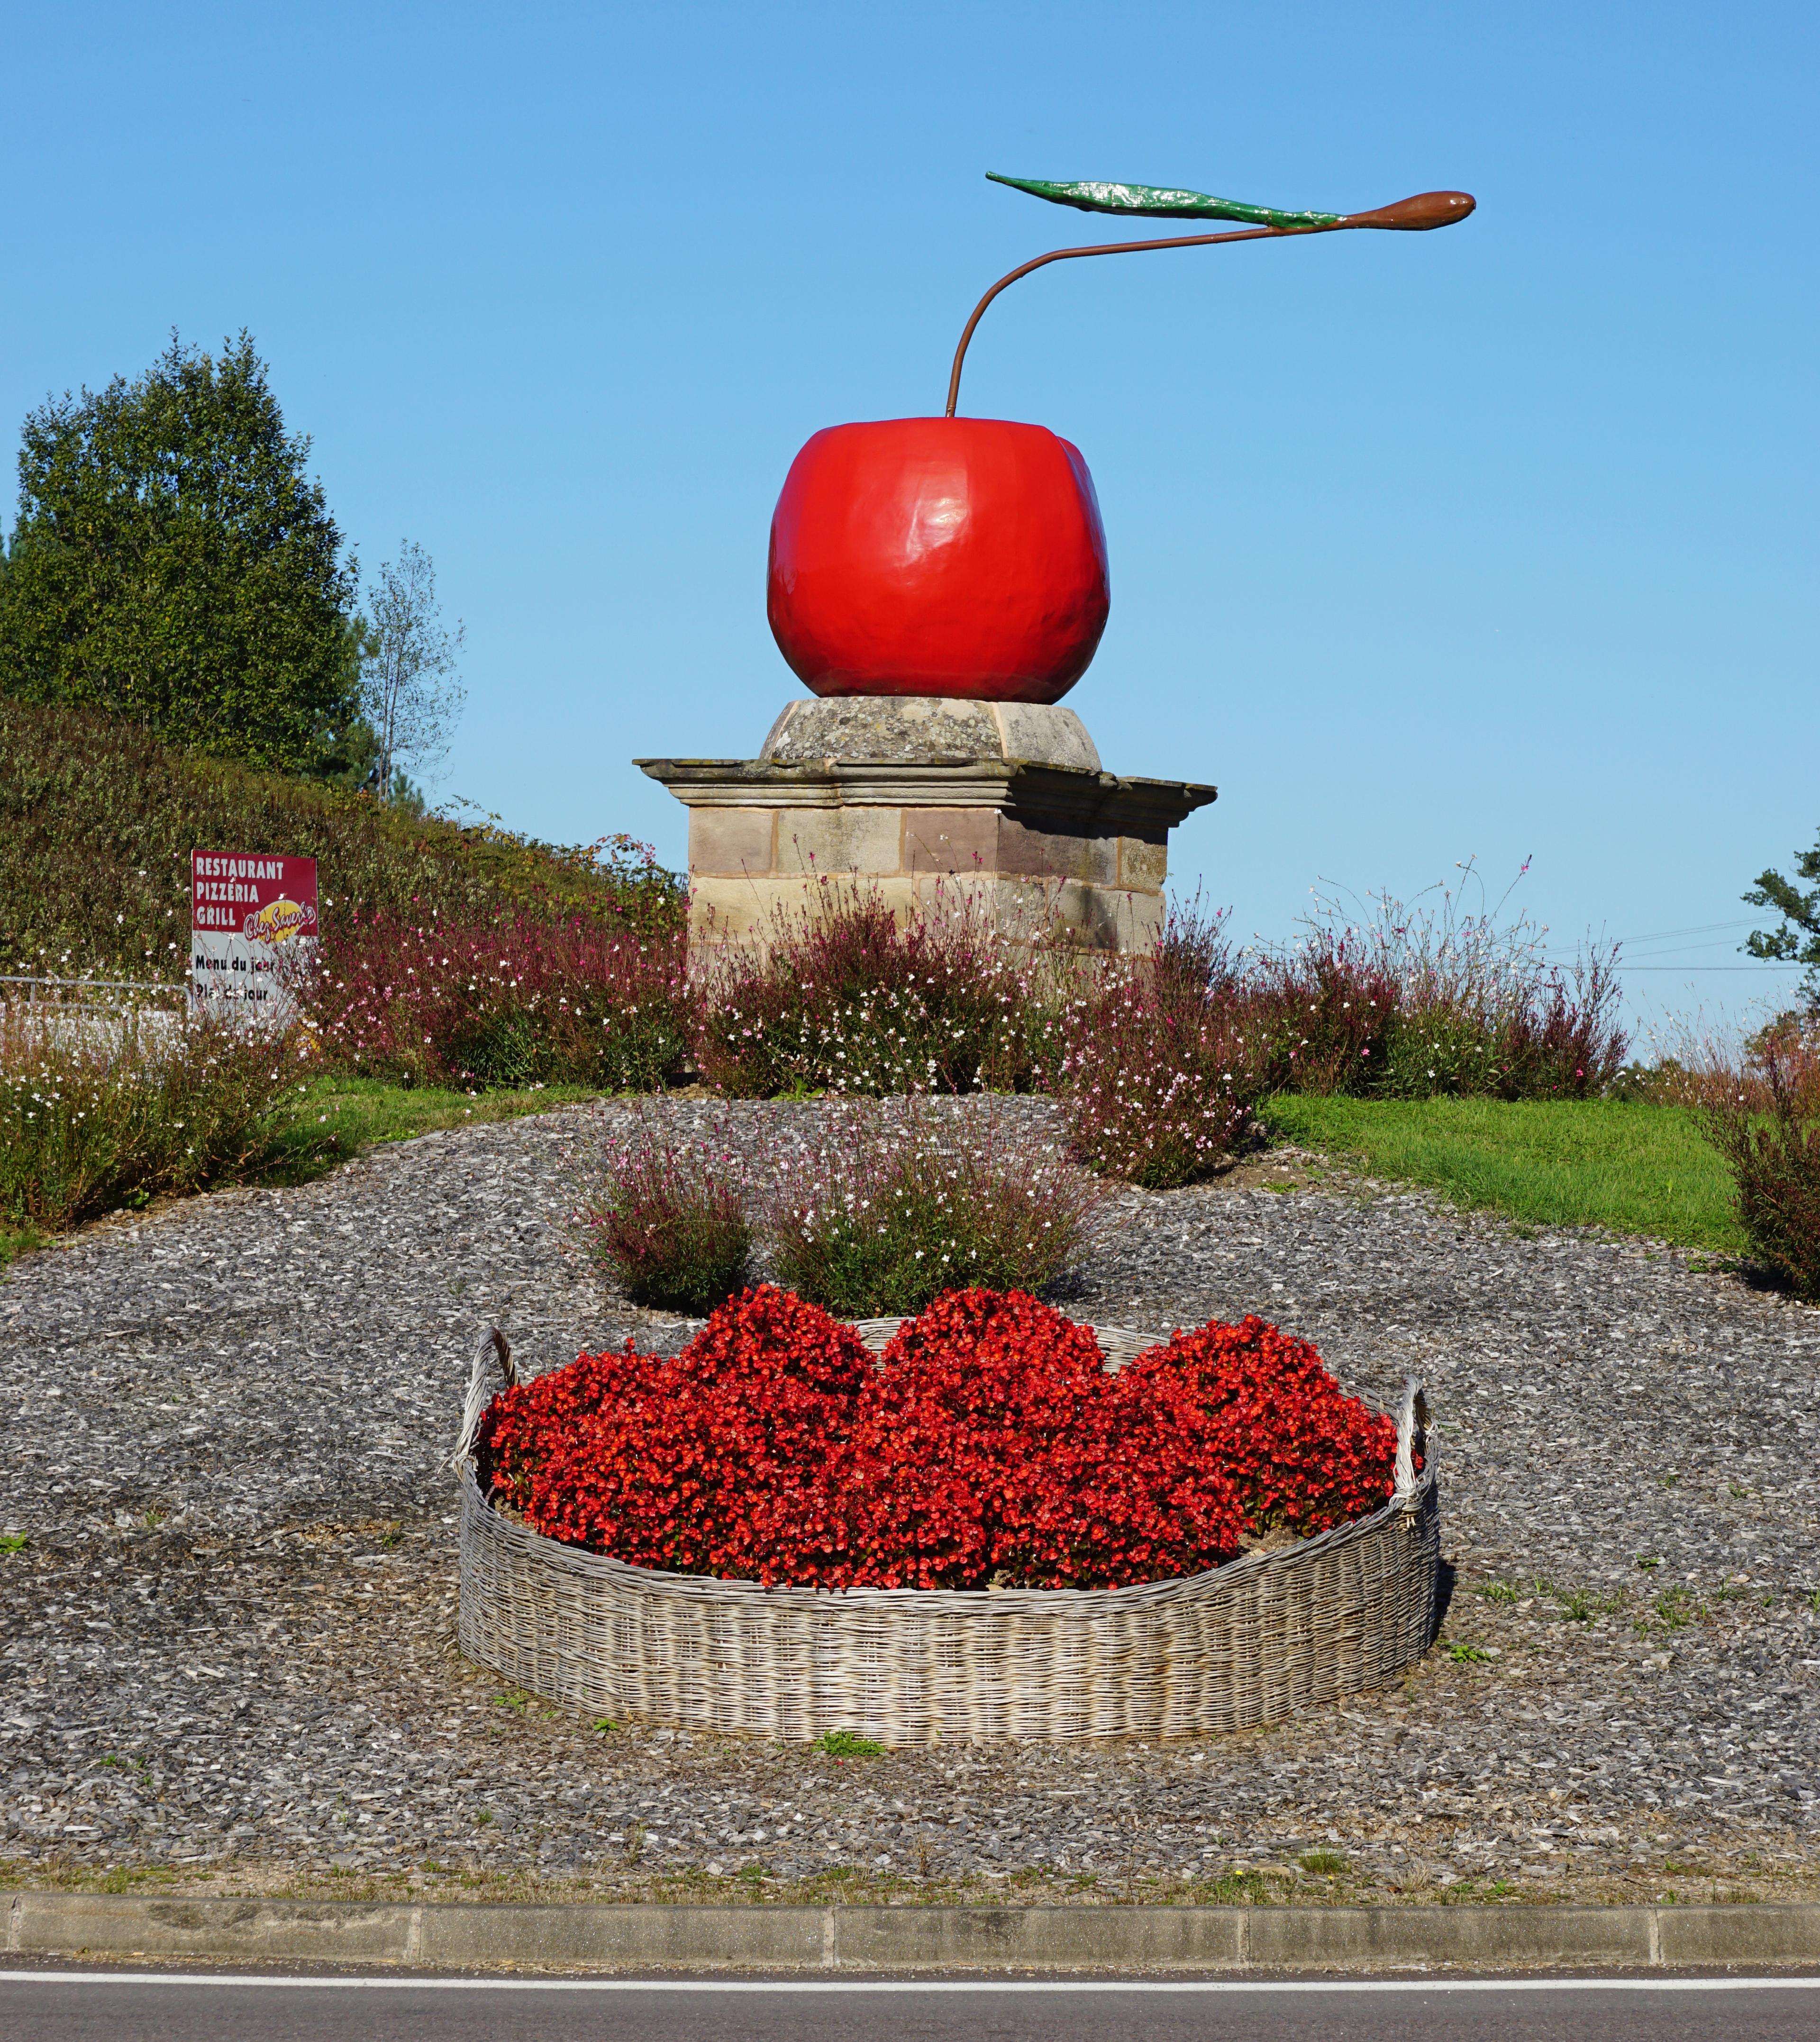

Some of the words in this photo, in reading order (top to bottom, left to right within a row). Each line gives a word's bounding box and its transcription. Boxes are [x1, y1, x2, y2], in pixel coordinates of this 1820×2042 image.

[196, 857, 283, 880] RESTAURANT
[196, 881, 259, 903] PIZZERIA
[196, 906, 236, 926] GRILL
[244, 911, 270, 944] Chez
[272, 902, 314, 932] Saverio
[196, 955, 227, 970] Menu
[231, 956, 246, 971] du
[243, 985, 268, 1002] jour
